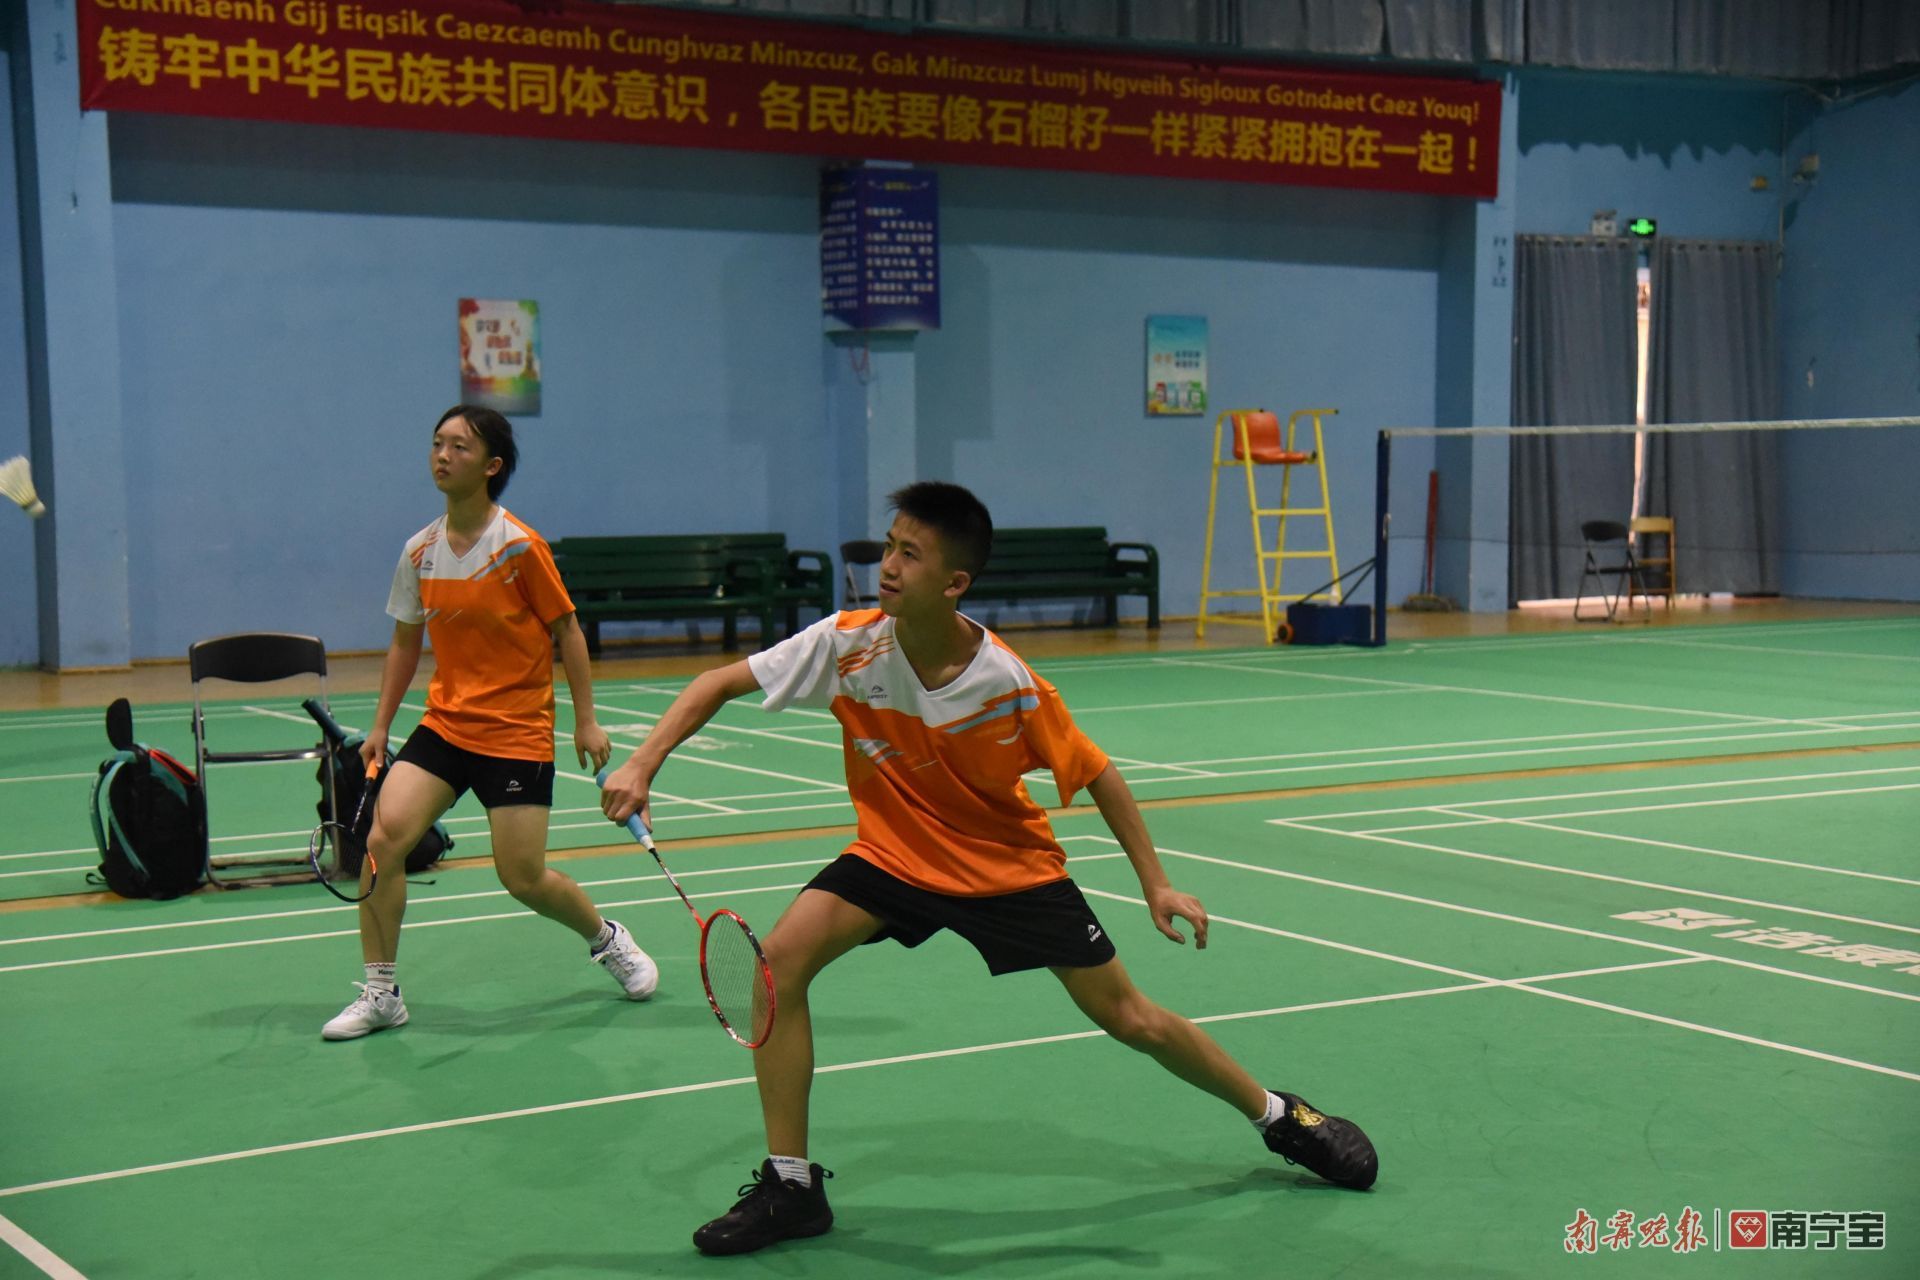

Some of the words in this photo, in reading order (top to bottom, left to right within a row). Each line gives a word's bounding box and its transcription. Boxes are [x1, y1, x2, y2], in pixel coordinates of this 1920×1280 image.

[284, 0, 328, 35] Gij
[336, 4, 428, 40] Eiqsik
[436, 13, 600, 50] Caezcaemh
[608, 28, 744, 64] Cunghvaz
[872, 51, 919, 77] Gak
[926, 56, 1025, 86] Minzcuz
[1031, 65, 1088, 96] Lumj
[1094, 69, 1174, 99] Ngveih
[1179, 76, 1261, 106] Sigloux
[1266, 84, 1366, 113] Gotndaet
[1370, 92, 1418, 116] Caez
[1423, 97, 1480, 126] Youq!
